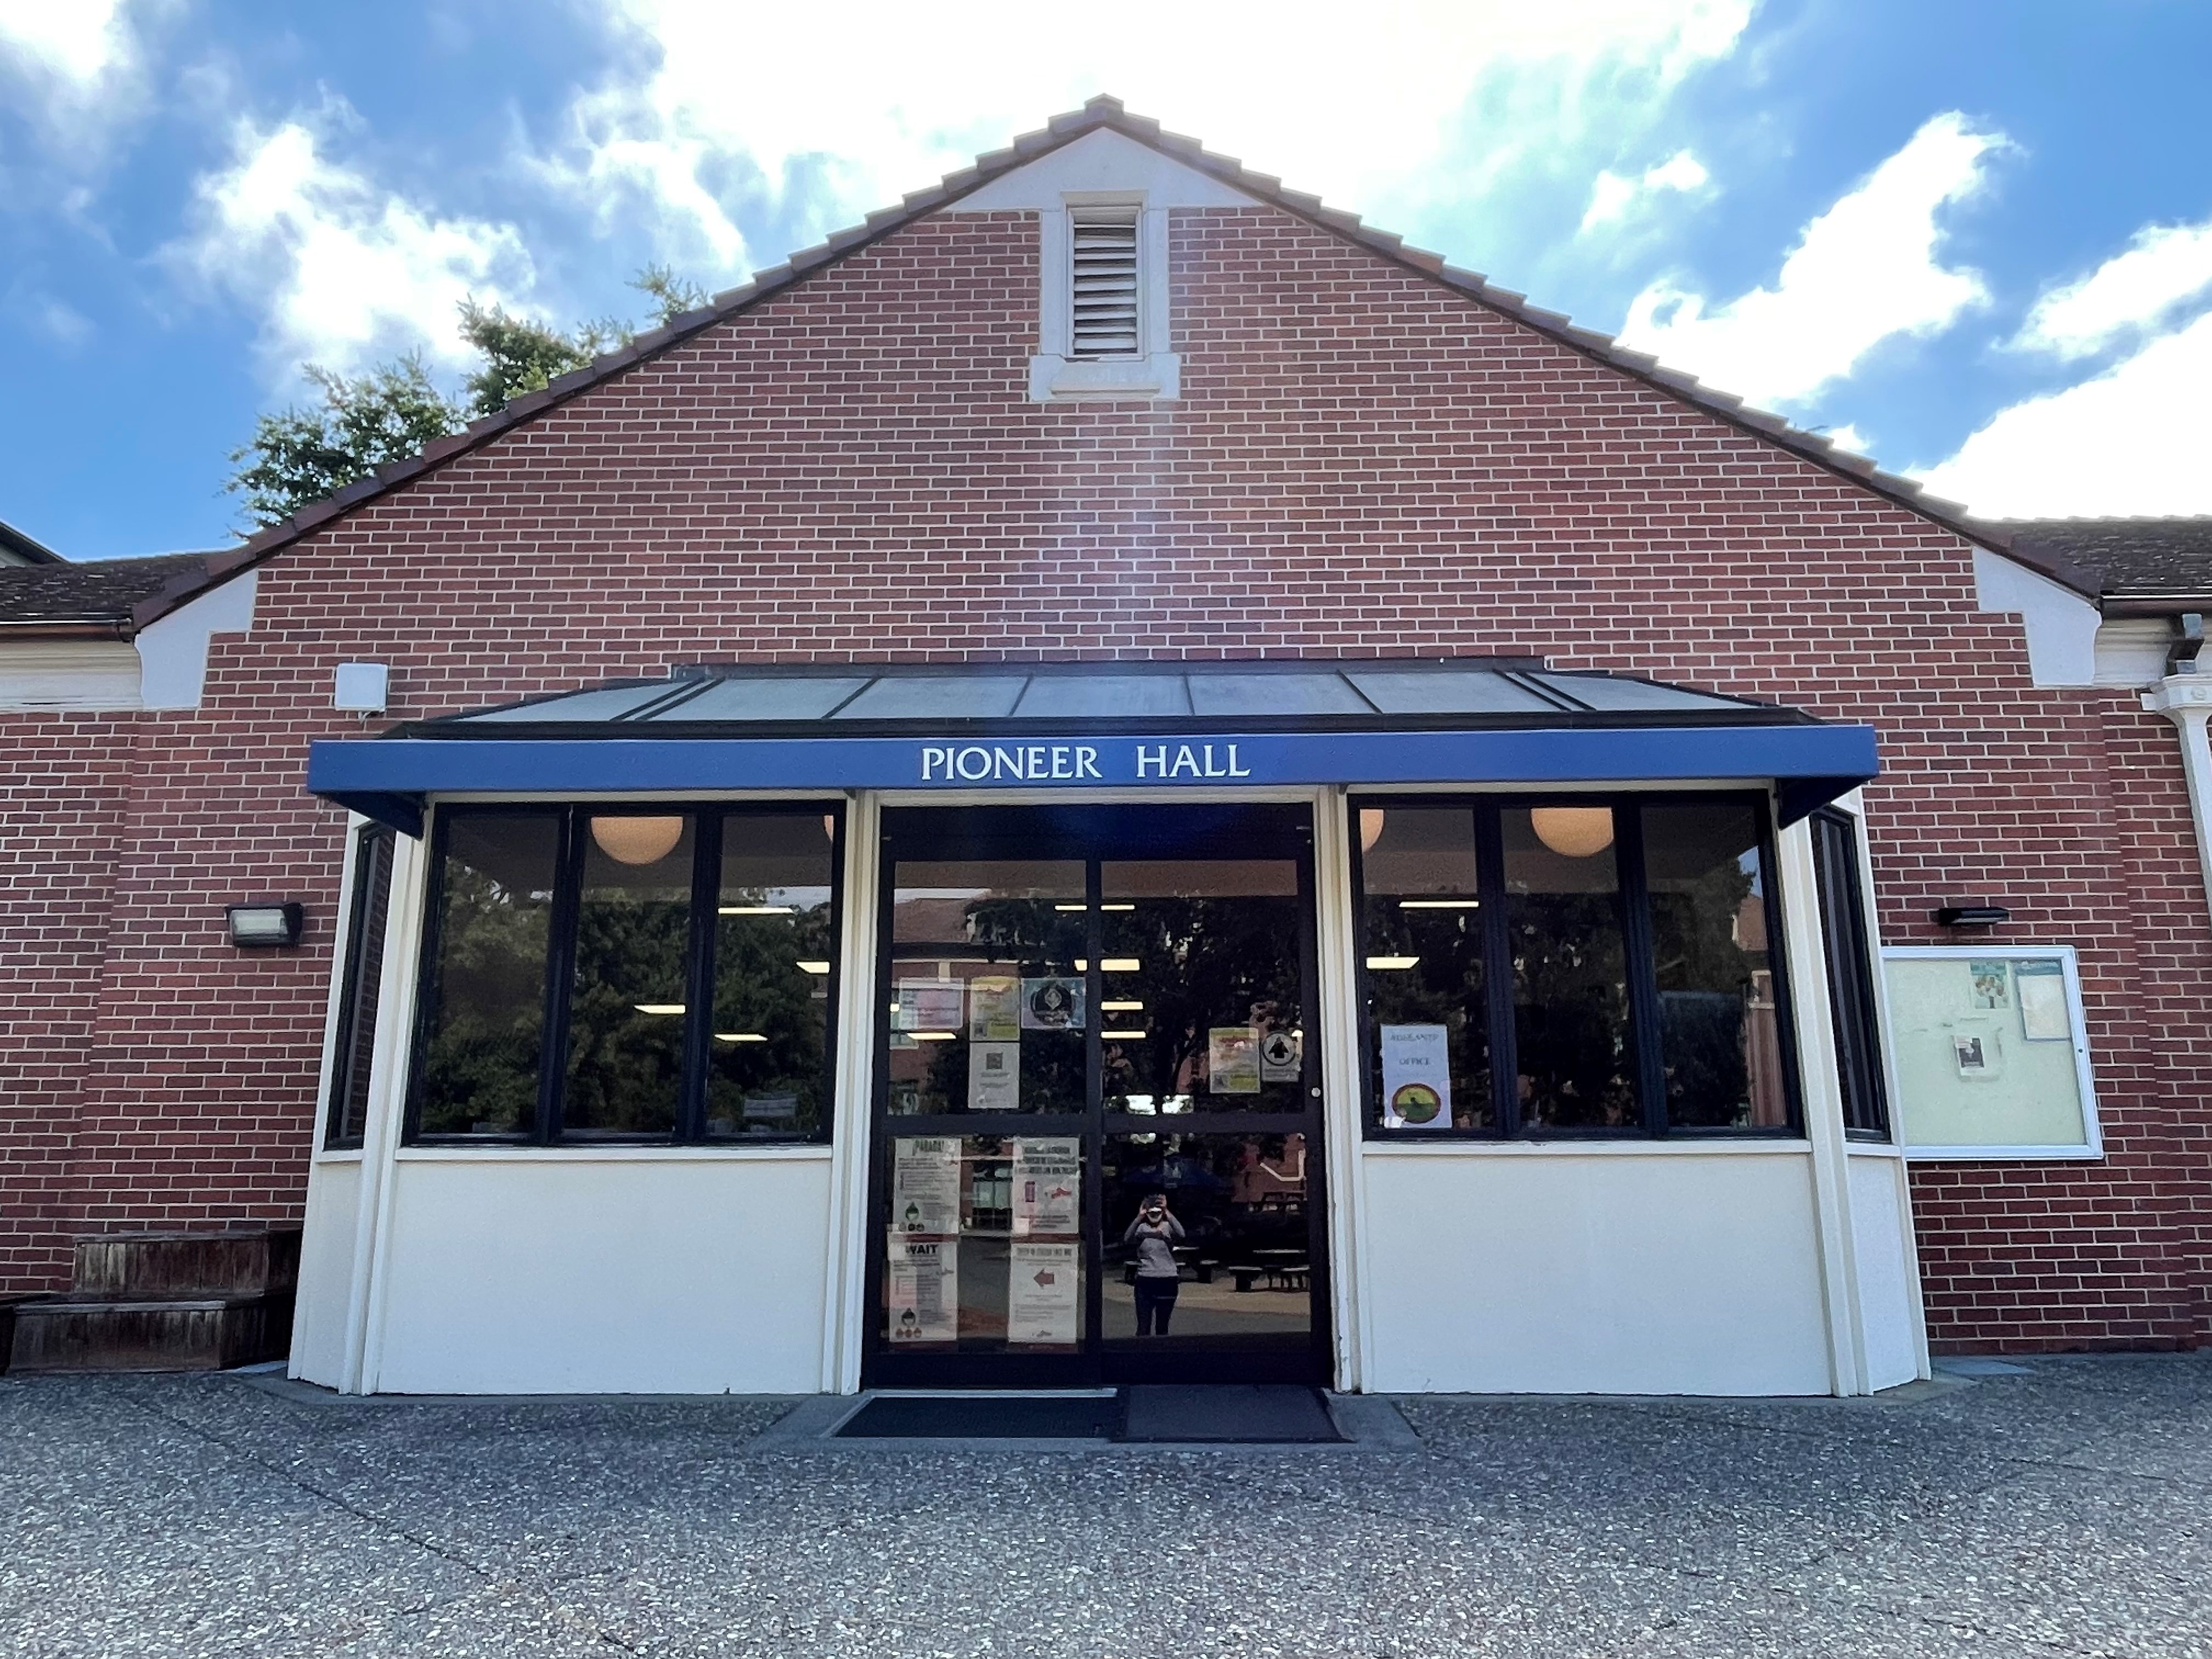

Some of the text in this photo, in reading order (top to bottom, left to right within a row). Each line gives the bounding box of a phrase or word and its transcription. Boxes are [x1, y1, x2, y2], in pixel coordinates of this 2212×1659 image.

[921, 744, 1251, 780] PIONEER HALL
[905, 1244, 939, 1255] WAIT
